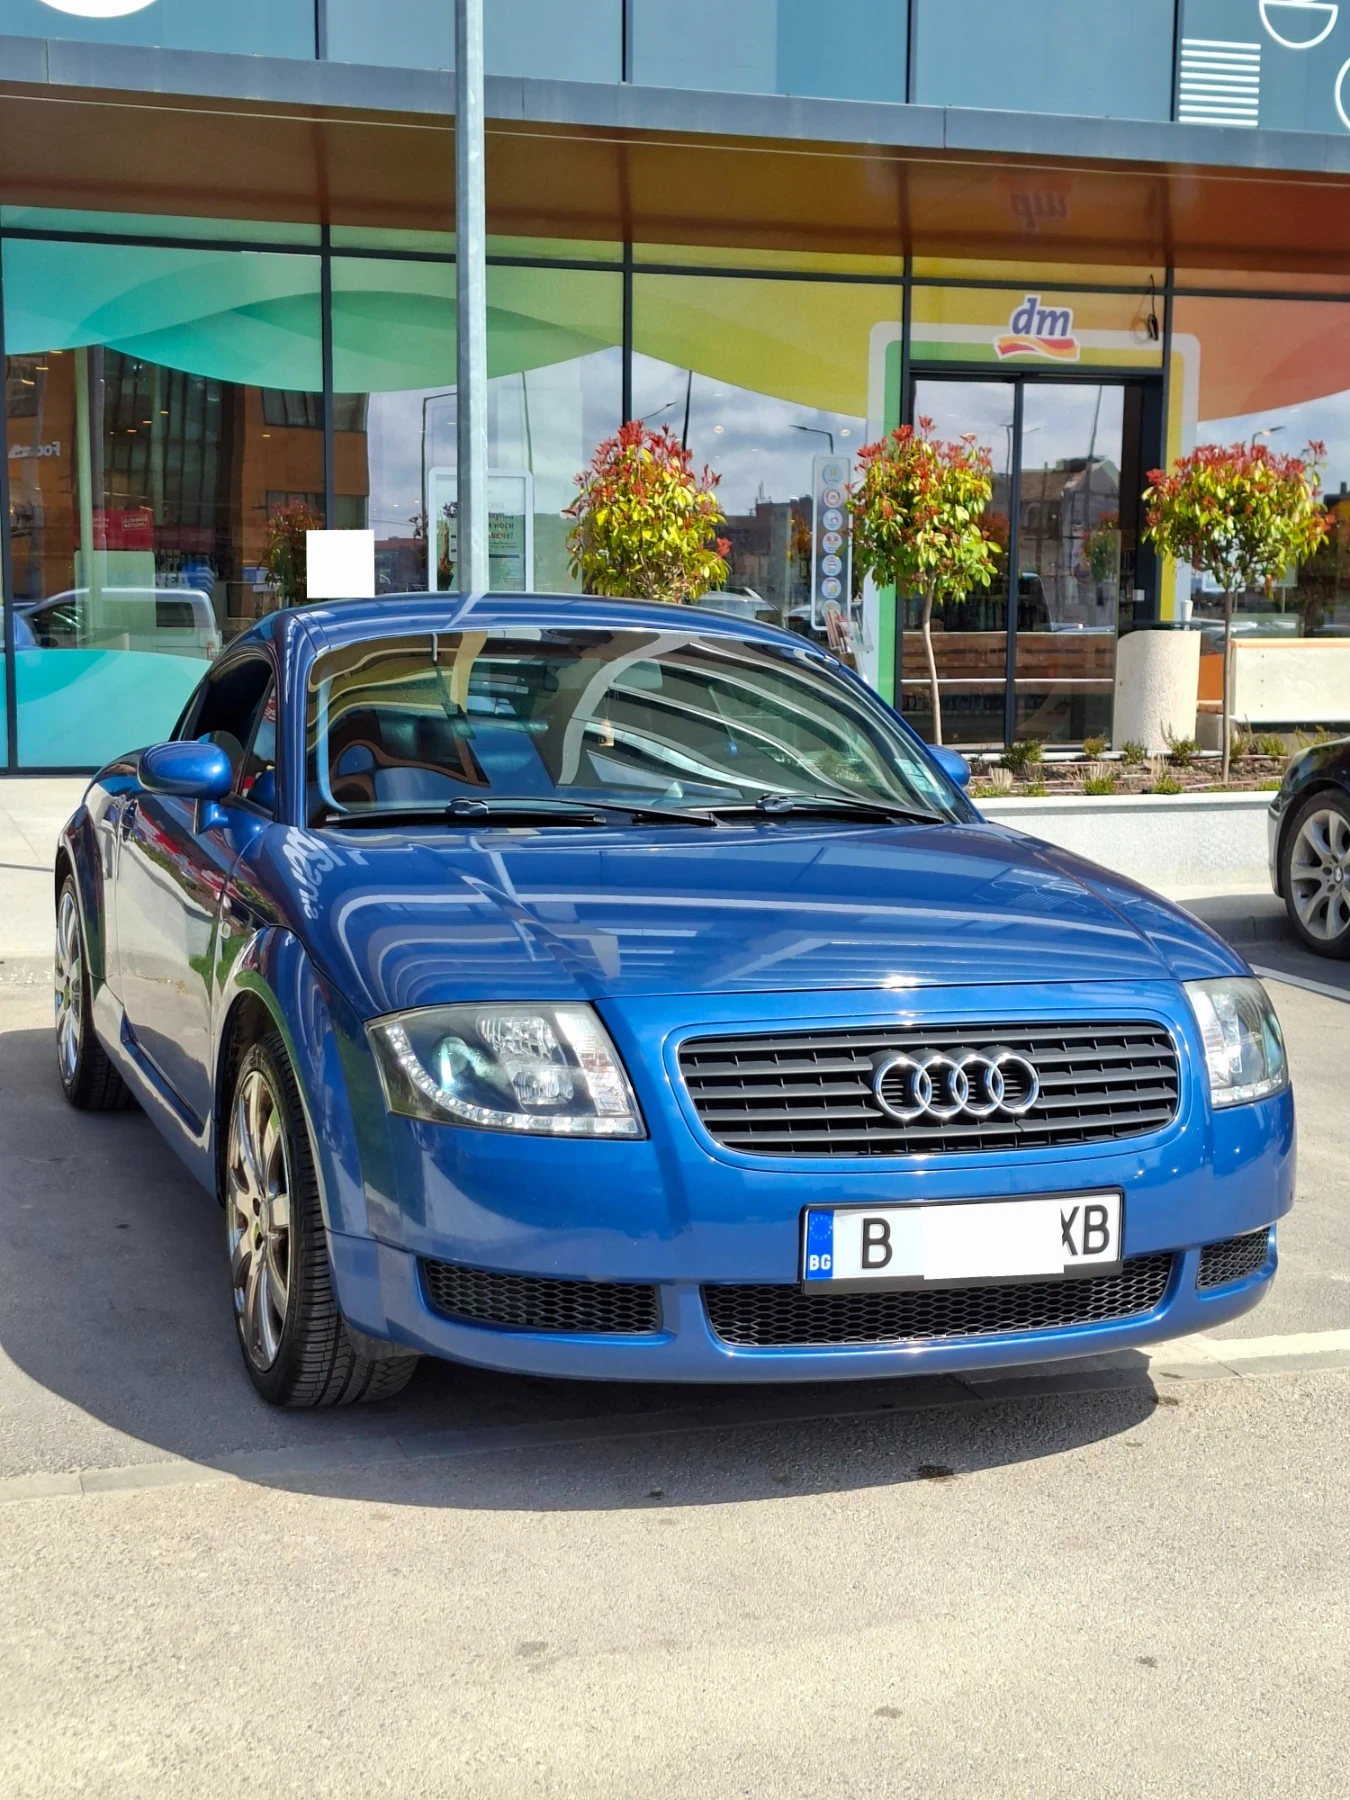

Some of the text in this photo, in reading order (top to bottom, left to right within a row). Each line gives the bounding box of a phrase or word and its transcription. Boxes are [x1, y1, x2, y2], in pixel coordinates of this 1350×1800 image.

[1012, 297, 1070, 337] dm
[808, 1253, 832, 1272] BG
[860, 1217, 894, 1270] B
